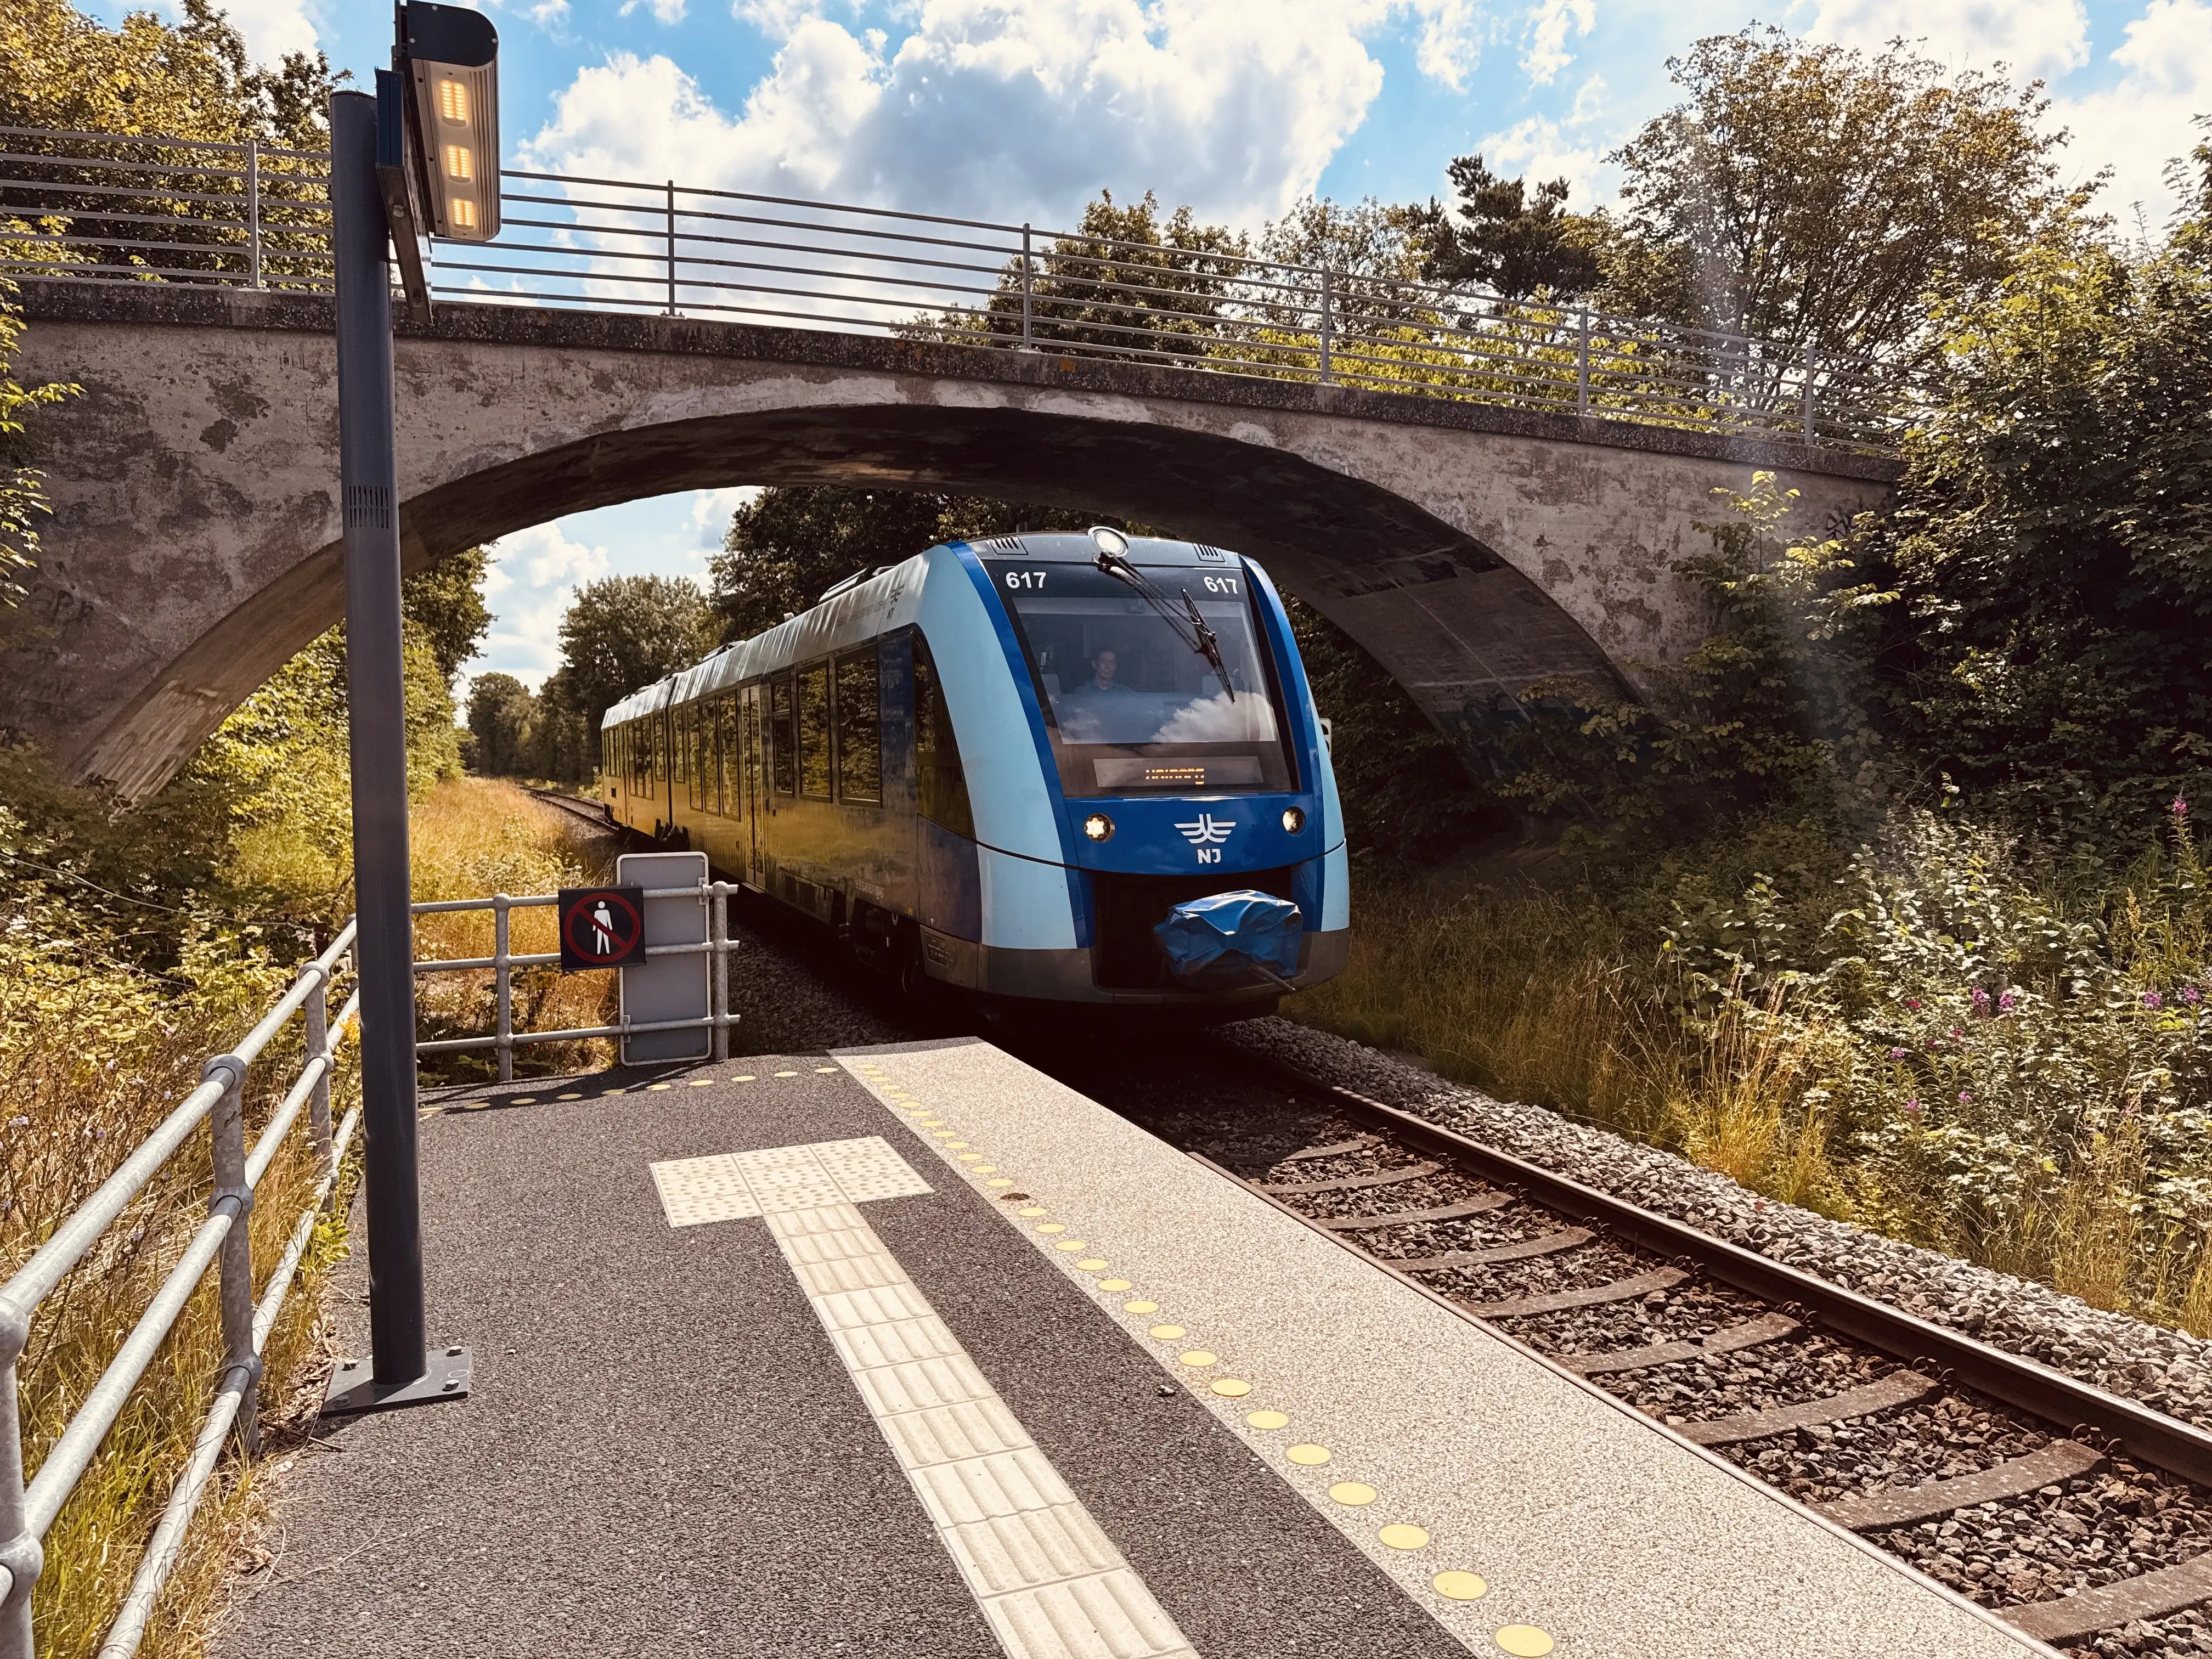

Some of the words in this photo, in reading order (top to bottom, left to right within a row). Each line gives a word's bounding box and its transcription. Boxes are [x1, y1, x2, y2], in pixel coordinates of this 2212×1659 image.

[1006, 572, 1046, 589] 617
[1204, 576, 1238, 594] 617
[1197, 848, 1221, 864] NJ
